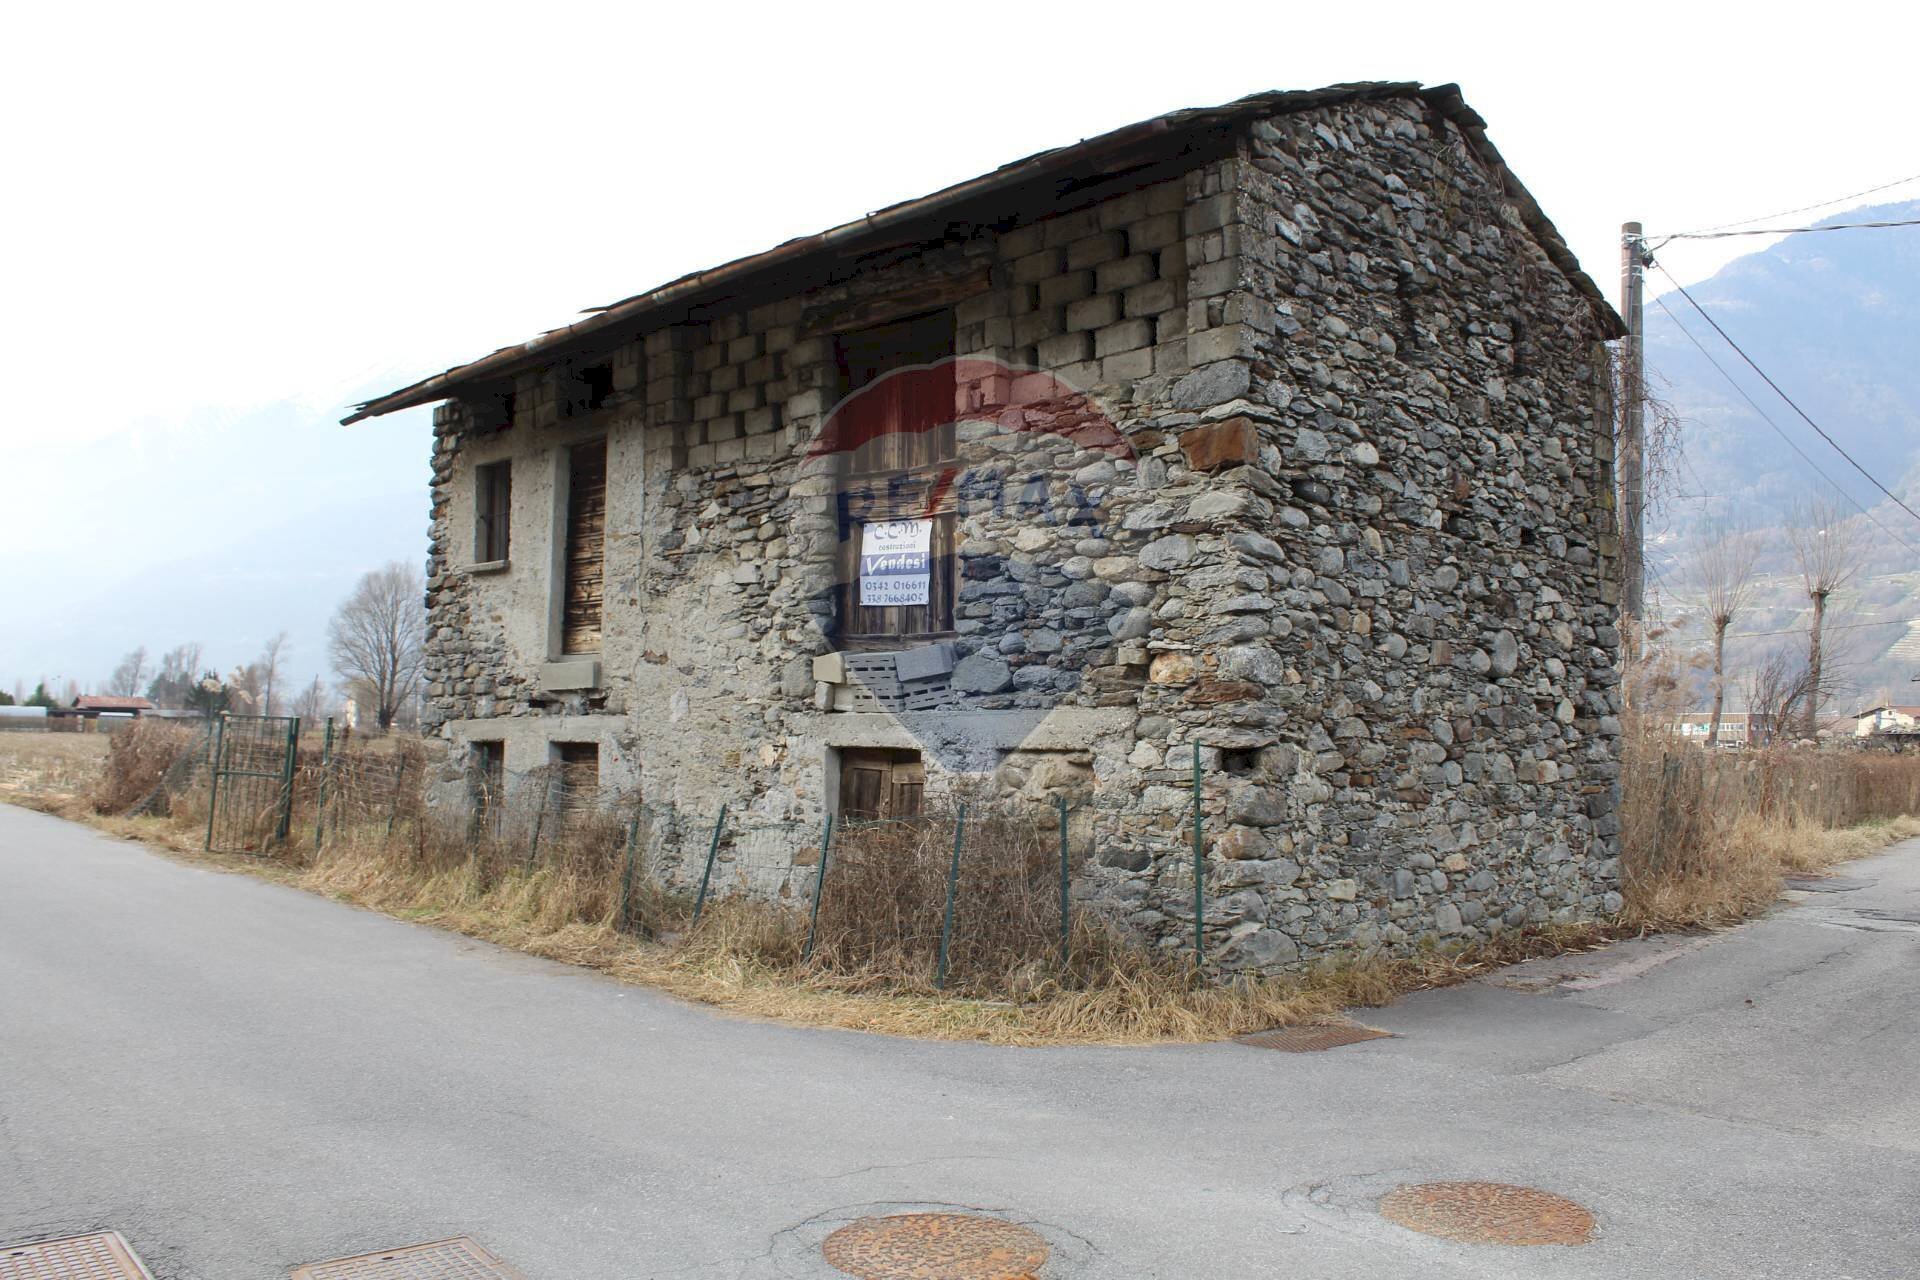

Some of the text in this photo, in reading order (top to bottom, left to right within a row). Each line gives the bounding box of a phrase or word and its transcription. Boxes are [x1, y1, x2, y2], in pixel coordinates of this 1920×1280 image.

[866, 552, 926, 576] Vendesi
[865, 580, 926, 591] 0342 016611
